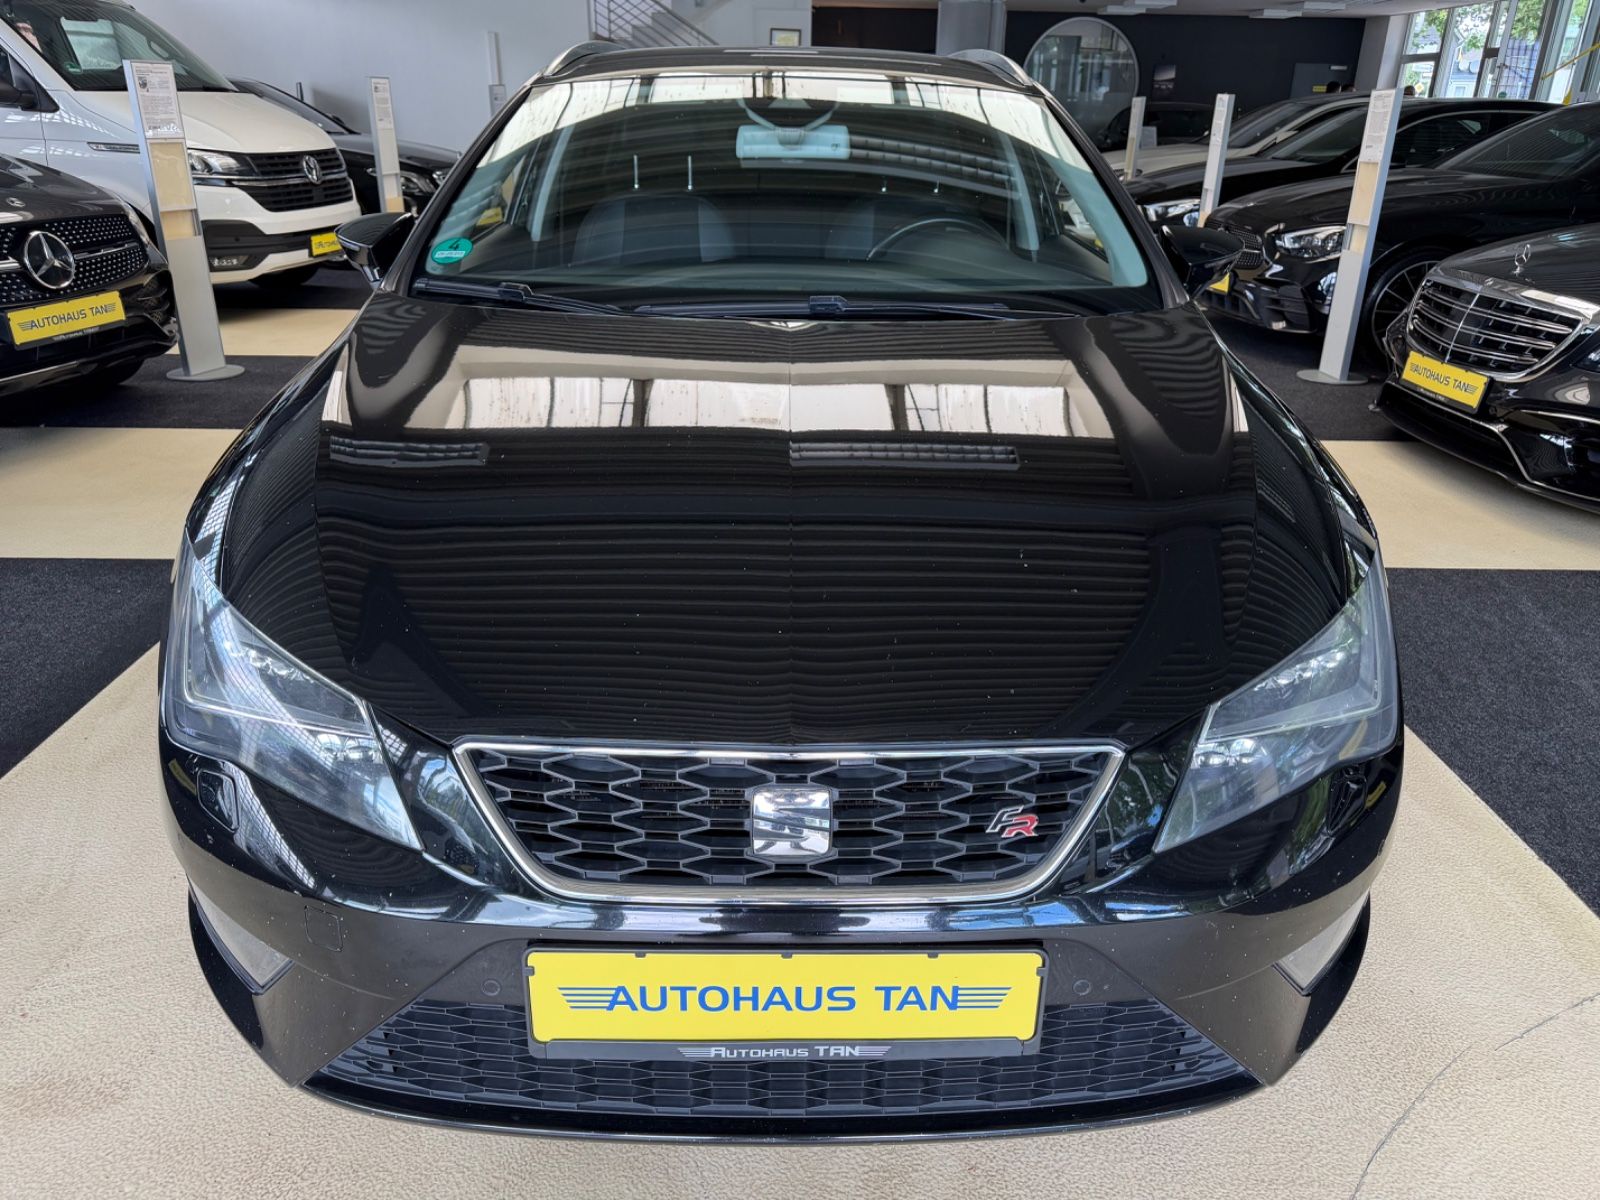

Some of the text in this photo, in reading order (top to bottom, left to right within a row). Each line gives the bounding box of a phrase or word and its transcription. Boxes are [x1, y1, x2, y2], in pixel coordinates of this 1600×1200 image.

[448, 239, 460, 250] 4
[29, 303, 109, 330] AUTOHAUS TAN
[1413, 364, 1469, 393] AUTOHAUS TAN
[985, 805, 1039, 838] FR
[606, 985, 960, 1012] AUTOHAUS TAN
[814, 1045, 860, 1057] TAN
